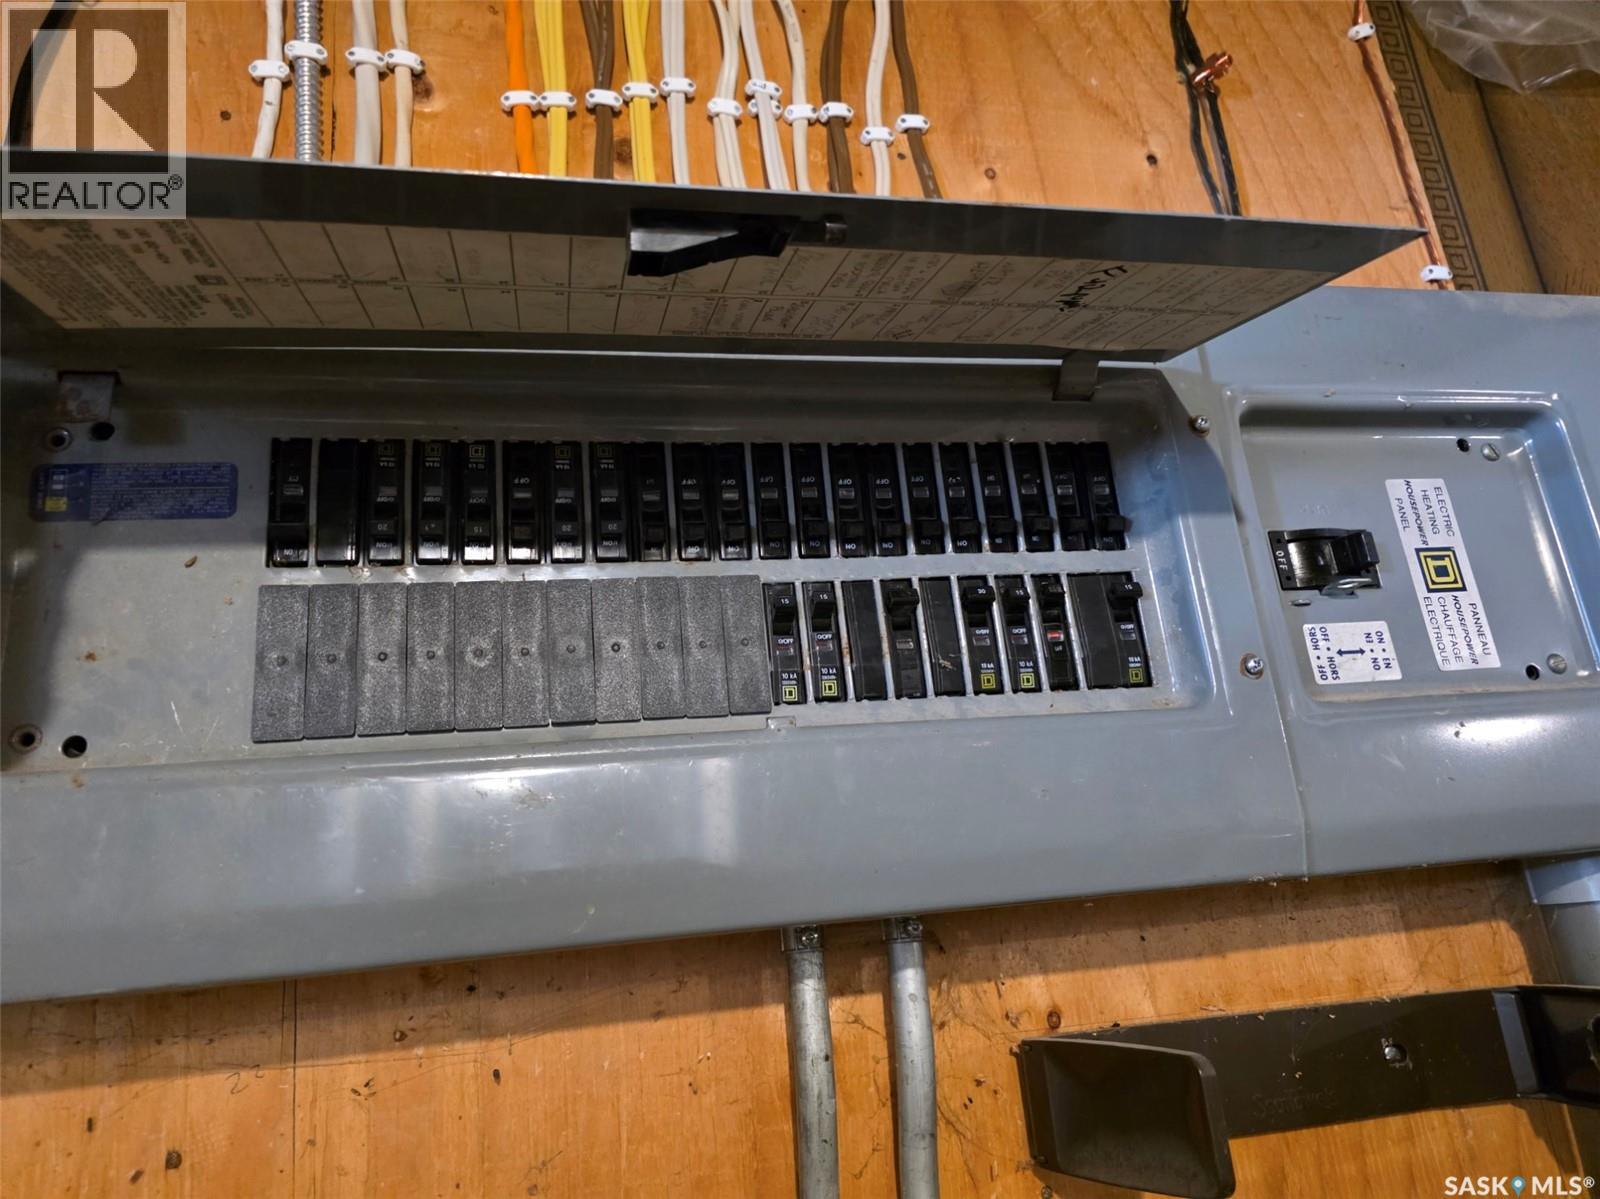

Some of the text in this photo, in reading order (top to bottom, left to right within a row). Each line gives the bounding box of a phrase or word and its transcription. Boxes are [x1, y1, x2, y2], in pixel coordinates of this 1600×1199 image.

[1395, 497, 1410, 532] PANEL
[1404, 480, 1429, 546] HOUSEPOWER
[1420, 489, 1440, 535] HEATING
[1434, 486, 1455, 537] ELECTRIC
[1275, 550, 1288, 571] OFF
[1308, 627, 1329, 681] OFF HORS
[1319, 626, 1341, 681] OFF HORS
[1375, 630, 1392, 669] ON EN
[1423, 596, 1451, 666] ELECTRIQUE
[1437, 596, 1464, 664] CHAUFFAGE
[1451, 594, 1479, 665] HOUSEPOWER
[1468, 602, 1492, 656] PANNEAU
